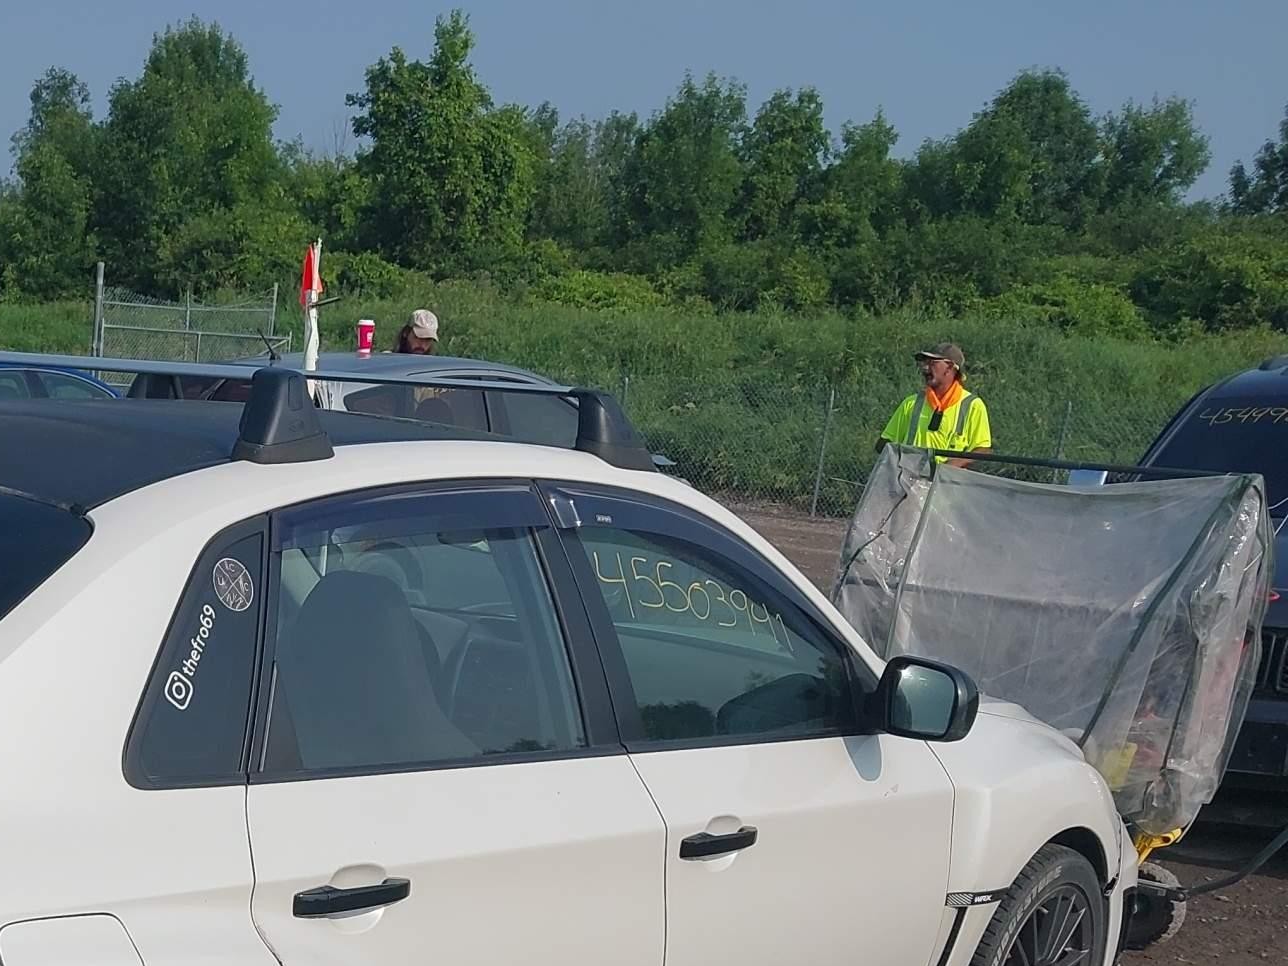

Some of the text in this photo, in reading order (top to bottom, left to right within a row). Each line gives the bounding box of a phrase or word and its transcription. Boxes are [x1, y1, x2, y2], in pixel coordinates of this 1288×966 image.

[1199, 407, 1288, 426] 45499
[592, 551, 794, 653] 45503941
[183, 604, 216, 676] thefro69
